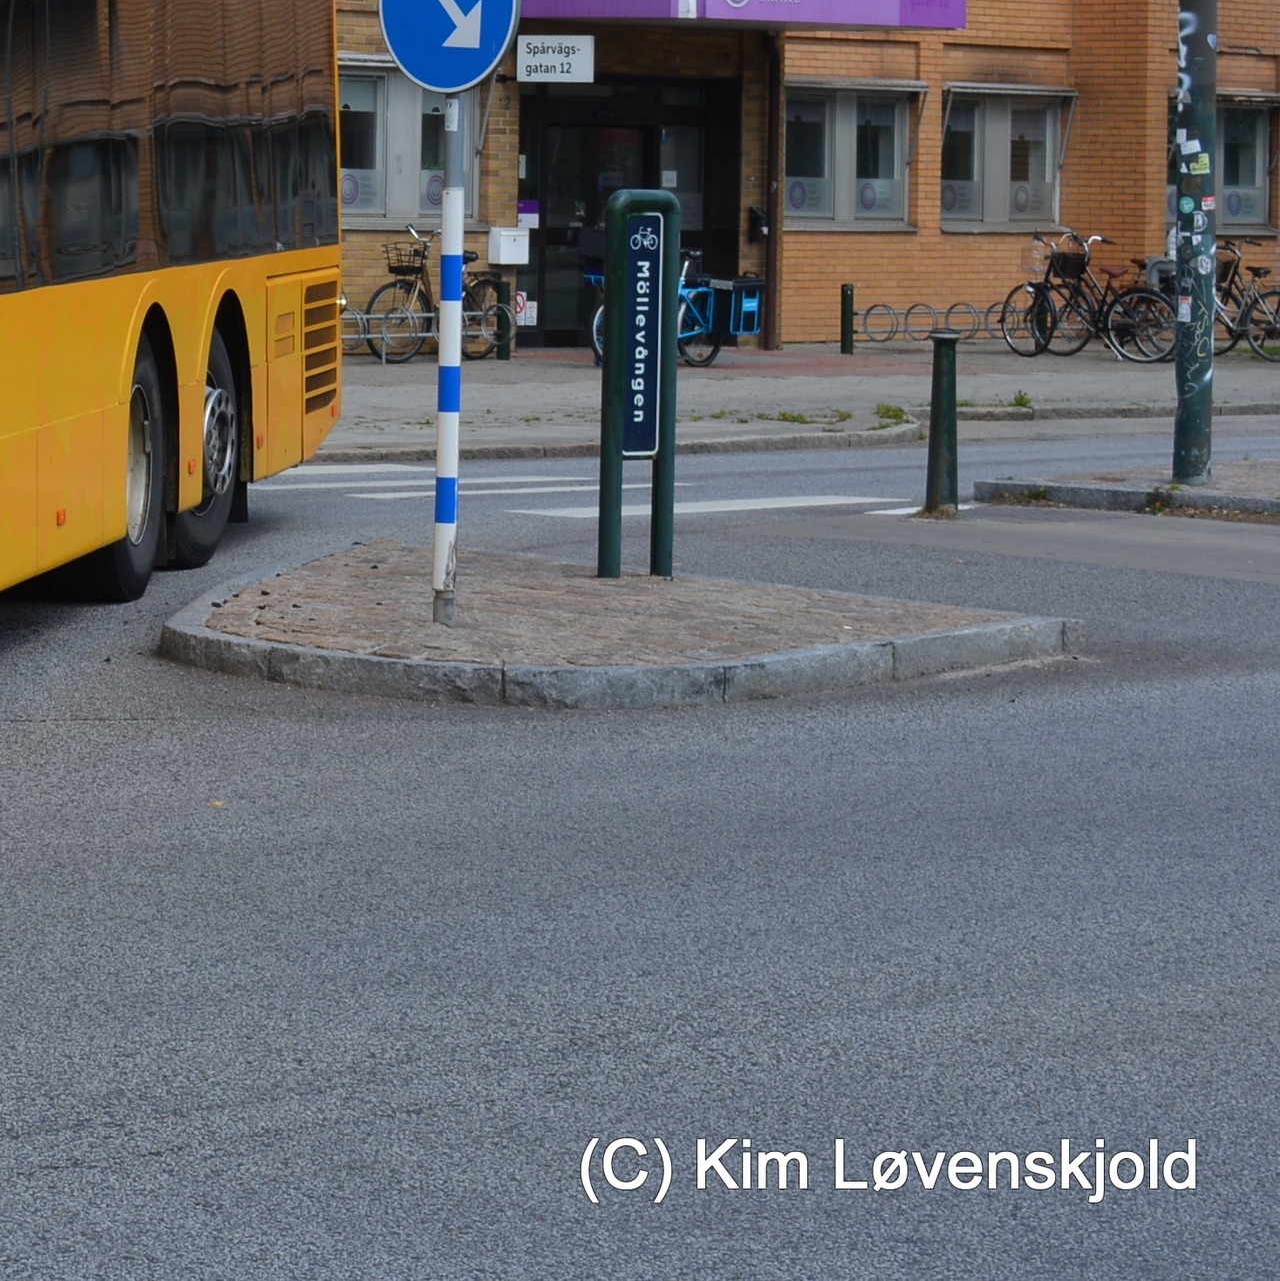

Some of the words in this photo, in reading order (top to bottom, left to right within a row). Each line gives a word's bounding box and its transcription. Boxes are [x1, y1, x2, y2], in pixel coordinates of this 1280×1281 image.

[525, 41, 581, 58] Spårvägs-
[525, 62, 557, 77] gatan
[559, 62, 572, 74] 12
[631, 260, 651, 422] Möllevången
